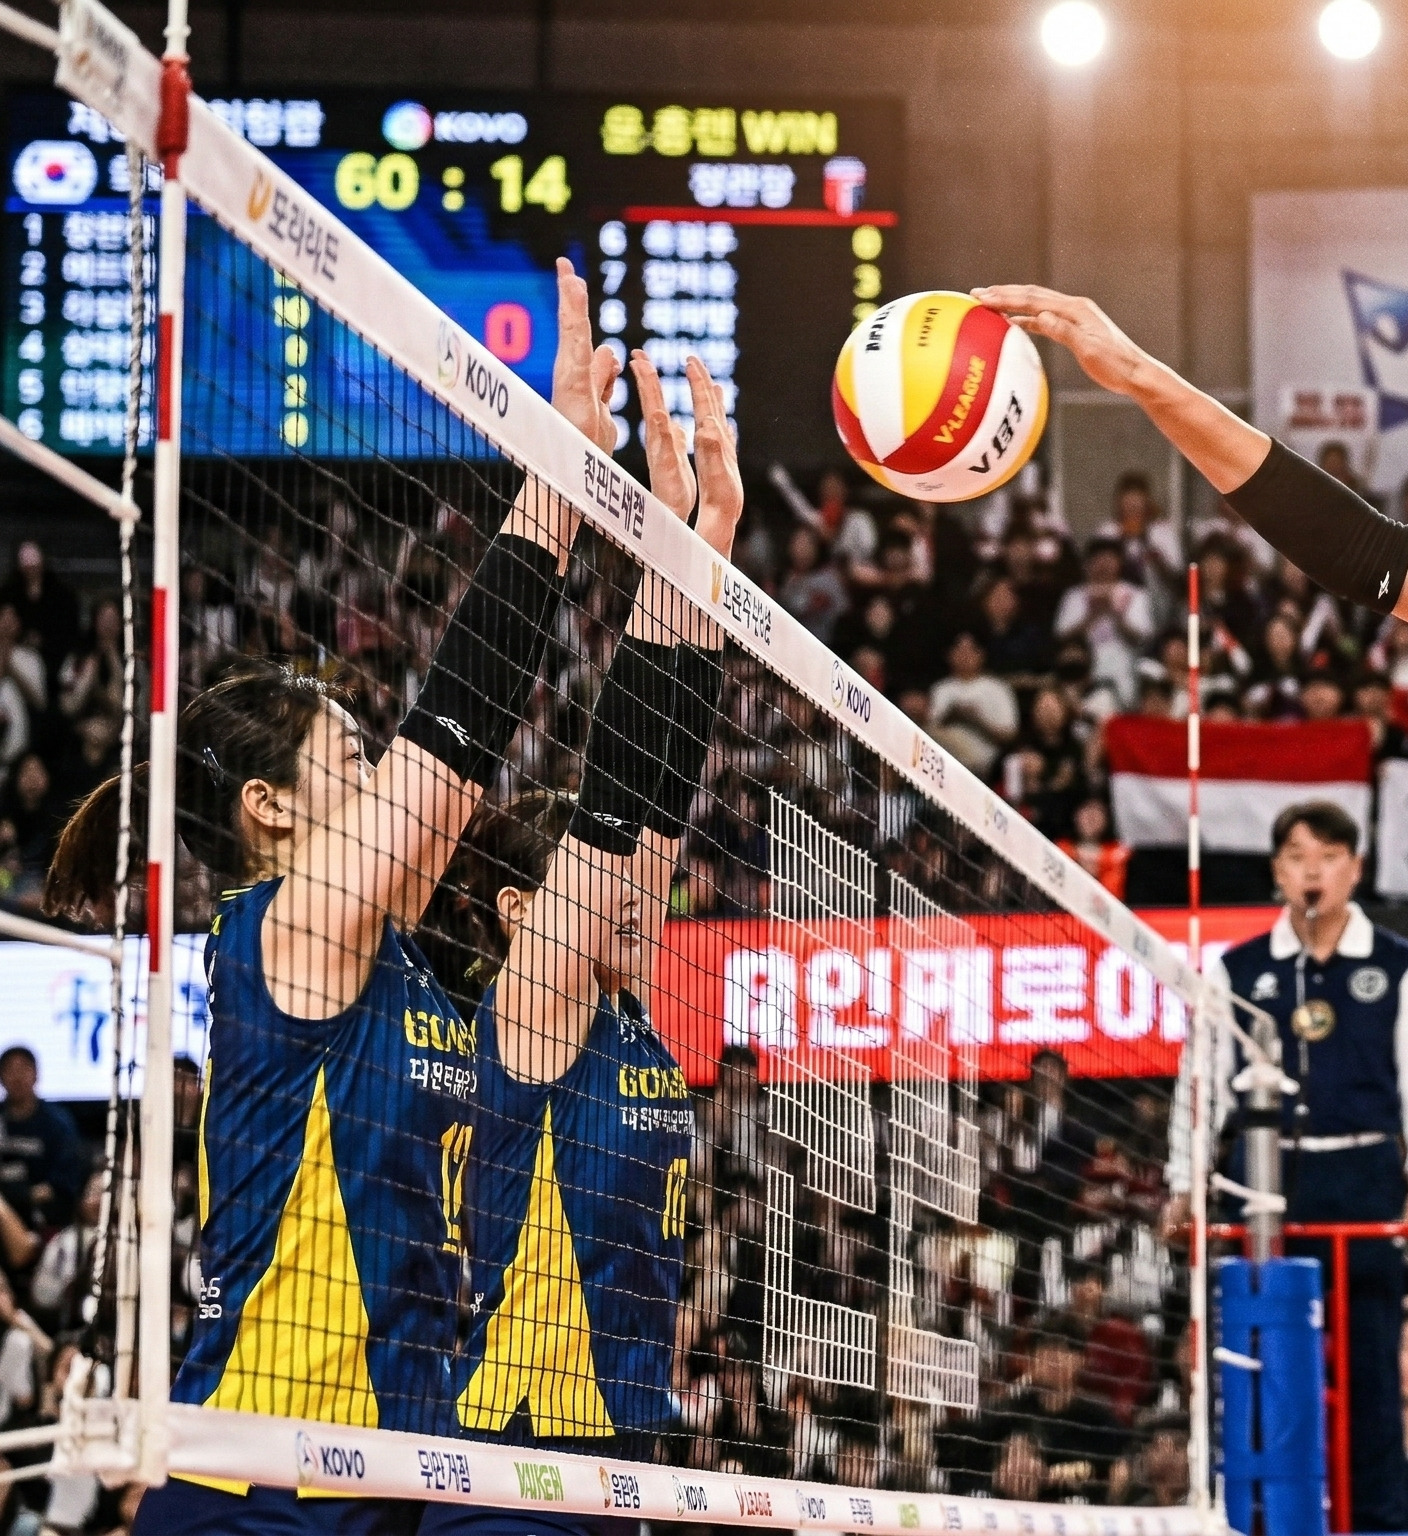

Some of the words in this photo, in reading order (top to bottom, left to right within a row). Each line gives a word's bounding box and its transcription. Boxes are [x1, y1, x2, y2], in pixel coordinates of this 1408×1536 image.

[741, 110, 838, 155] WIN
[336, 152, 420, 212] 60
[490, 154, 572, 214] 14
[22, 212, 43, 246] 1
[19, 250, 47, 286] 2
[600, 260, 628, 295] 7
[18, 290, 46, 325] 3
[17, 329, 45, 363] 4
[465, 352, 509, 418] KOVO
[846, 681, 871, 723] KOVO
[319, 1446, 366, 1479] KOVO
[683, 1484, 708, 1512] KOVO
